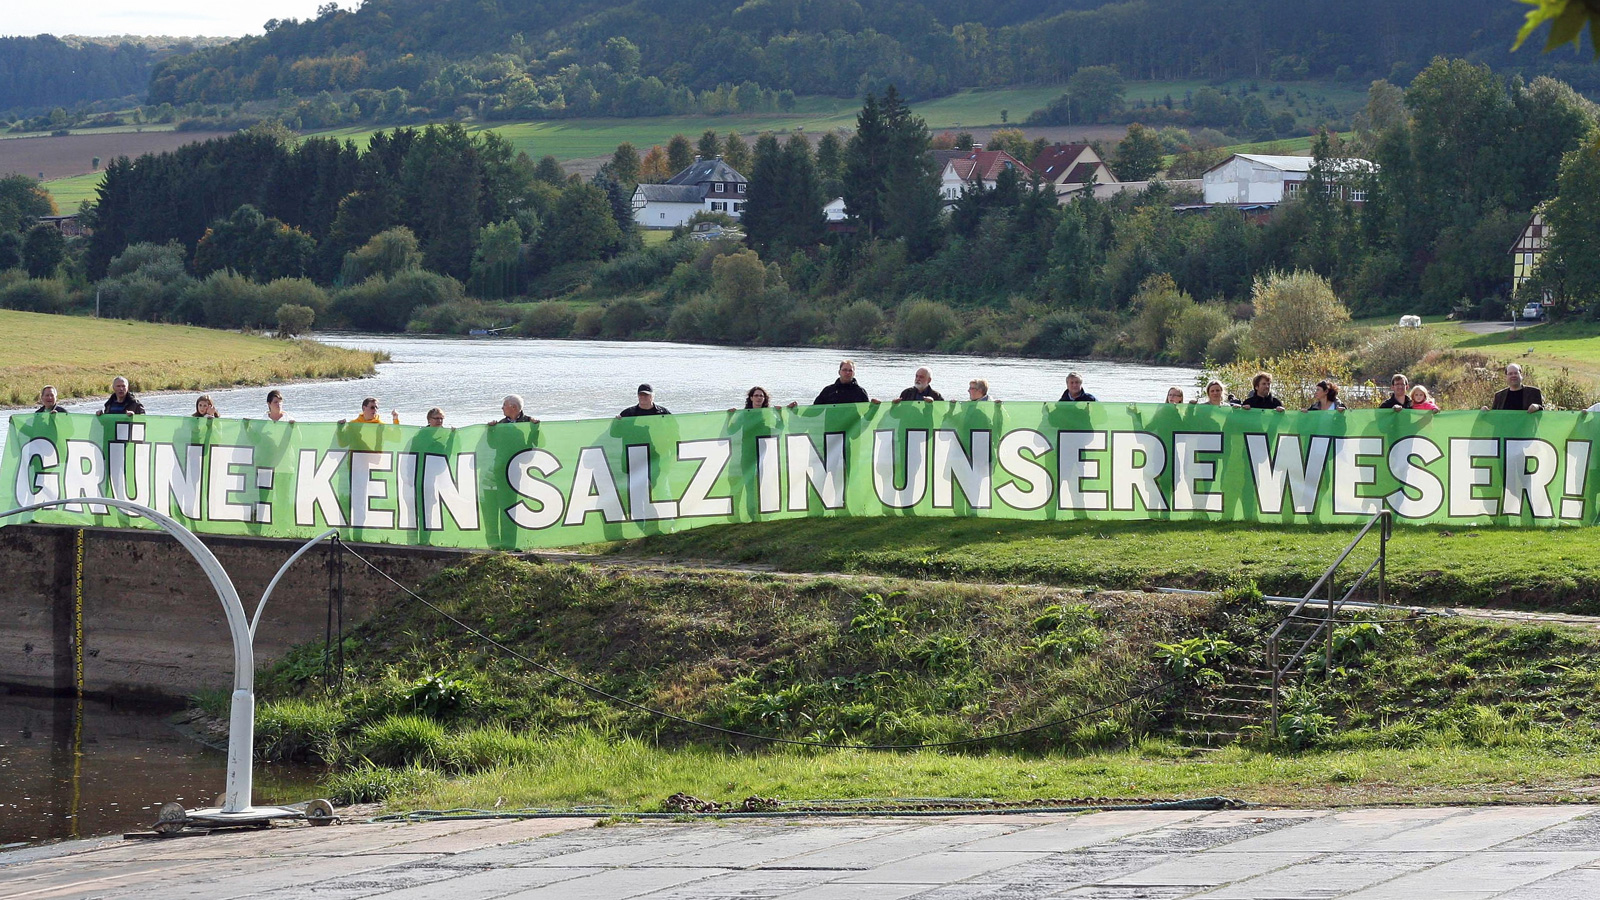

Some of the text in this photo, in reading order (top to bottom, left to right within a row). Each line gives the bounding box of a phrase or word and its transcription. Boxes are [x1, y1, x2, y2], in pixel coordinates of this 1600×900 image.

[15, 422, 1592, 531] GRÜNE: KEIN SALZ IN UNSERE WESER!
